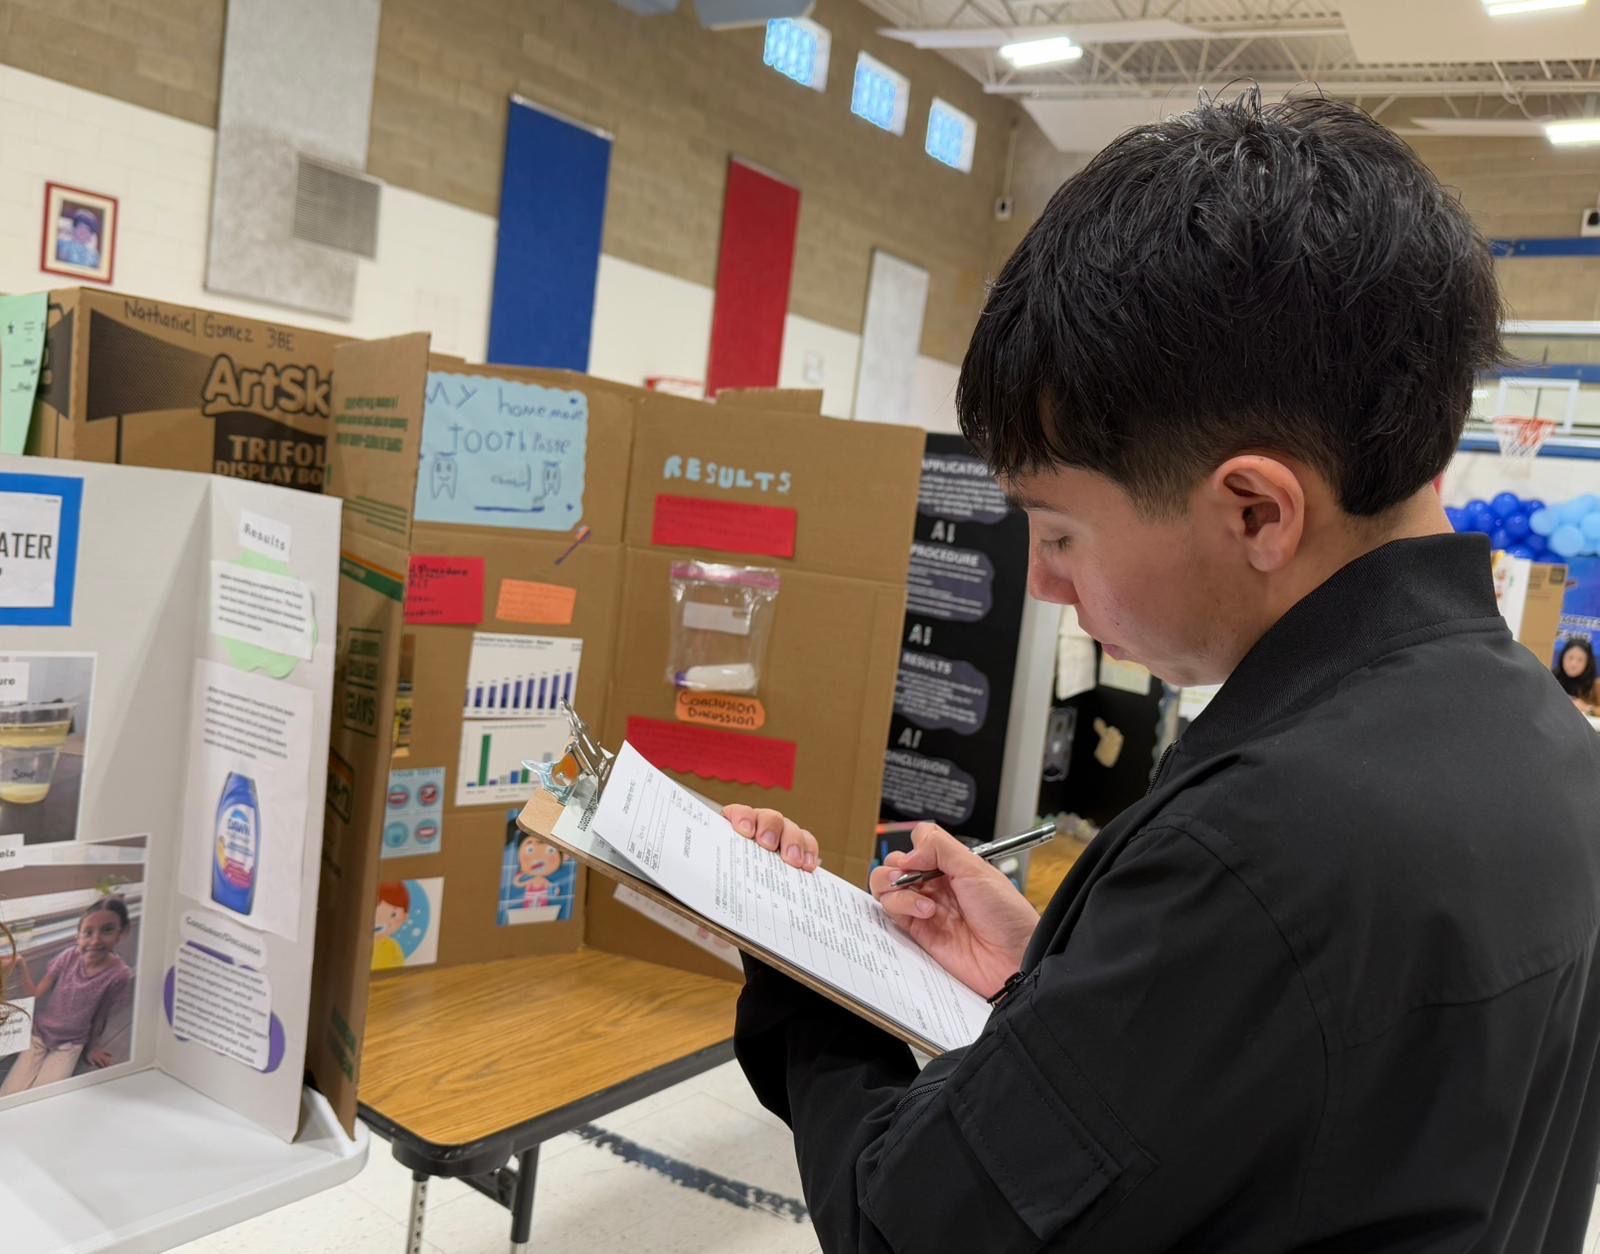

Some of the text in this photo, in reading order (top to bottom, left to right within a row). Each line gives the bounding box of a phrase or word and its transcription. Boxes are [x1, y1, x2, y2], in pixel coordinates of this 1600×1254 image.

[124, 299, 197, 337] Nathaniel
[203, 315, 255, 343] Gomez
[202, 353, 333, 418] ArtSk
[228, 434, 326, 467] TRIFOL
[215, 459, 323, 486] DISPLAY BO
[663, 454, 792, 494] RESULTS
[922, 458, 996, 477] APPLICATIO
[0, 531, 53, 560] ATER
[244, 522, 286, 551] Results
[903, 651, 953, 676] RESULTS
[886, 751, 950, 777] ONCLUSION
